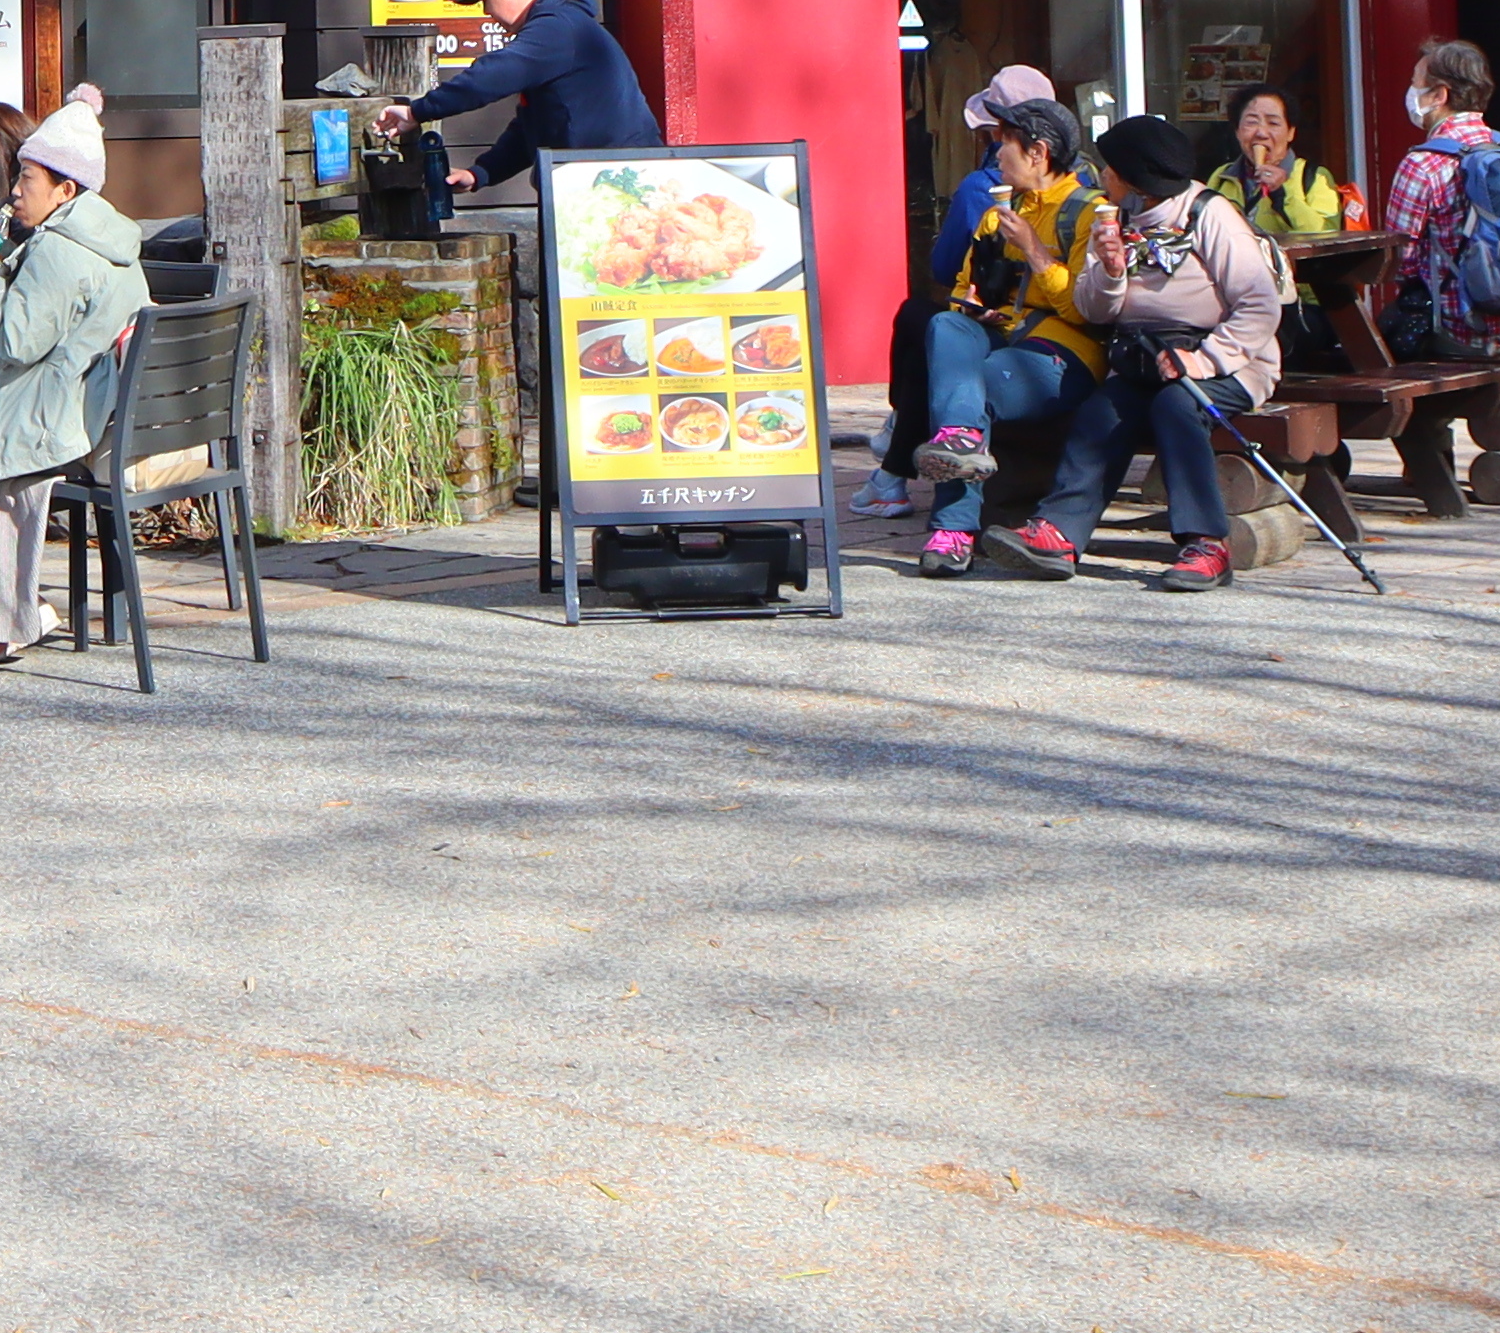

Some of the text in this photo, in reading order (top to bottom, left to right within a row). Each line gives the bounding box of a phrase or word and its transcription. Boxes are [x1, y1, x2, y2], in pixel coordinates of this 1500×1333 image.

[639, 486, 756, 505] 五千尺キッチン
